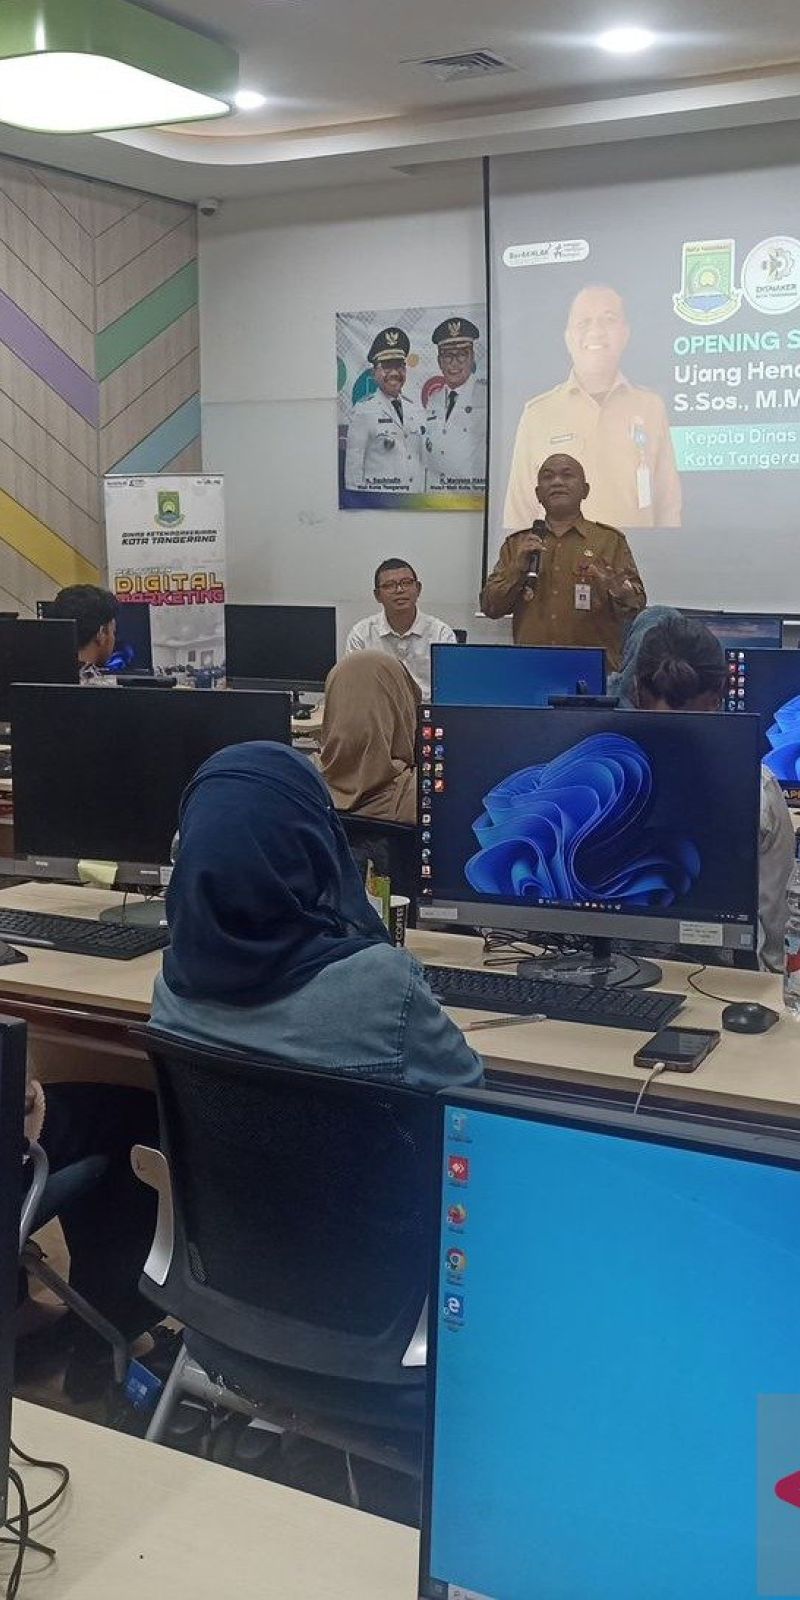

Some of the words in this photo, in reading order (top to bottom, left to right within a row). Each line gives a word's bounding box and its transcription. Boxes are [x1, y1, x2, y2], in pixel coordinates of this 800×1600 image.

[674, 331, 780, 355] OPENING
[674, 363, 742, 387] Ujang
[674, 392, 749, 411] S.Sos.,
[685, 429, 744, 448] Kepala
[749, 428, 798, 443] Dinas
[685, 452, 723, 467] Kota
[728, 451, 800, 469] Tangera
[121, 537, 149, 546] KOTA
[152, 535, 216, 544] TANGERANG
[115, 572, 224, 595] DIGITAL
